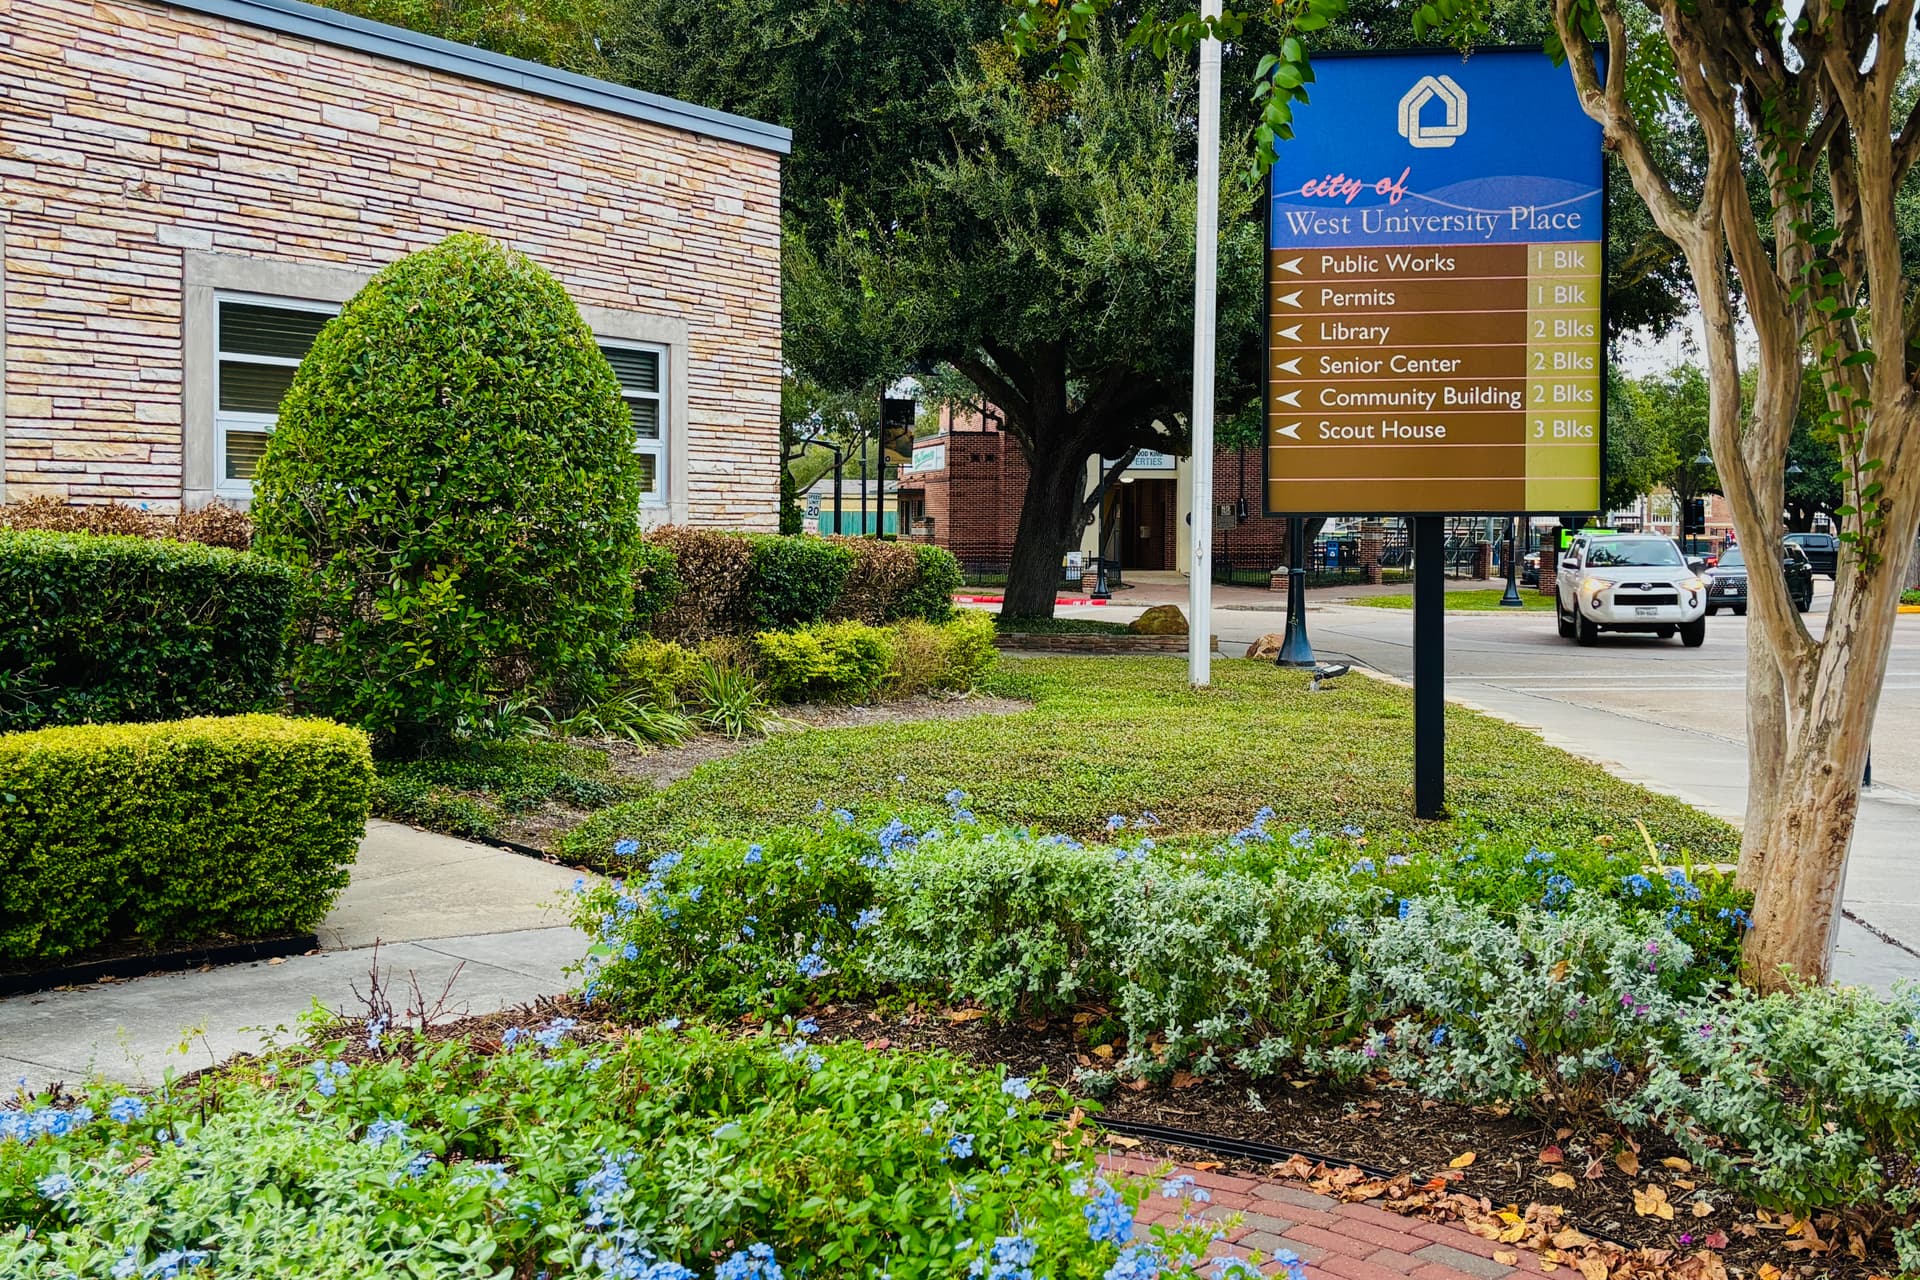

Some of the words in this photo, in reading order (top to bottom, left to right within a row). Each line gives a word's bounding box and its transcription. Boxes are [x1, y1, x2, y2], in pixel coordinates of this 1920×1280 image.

[1301, 172, 1362, 205] city
[1375, 166, 1411, 206] of
[1286, 210, 1351, 236] West
[1360, 206, 1498, 238] University
[1509, 205, 1581, 231] Place
[1320, 255, 1379, 274] Public
[1385, 252, 1456, 271] Works
[1554, 250, 1585, 269] Blk
[1320, 288, 1396, 307] Permits
[1555, 285, 1586, 304] Blk
[1320, 322, 1390, 345] Library
[1534, 319, 1546, 338] 2
[1554, 319, 1594, 338] Blks
[1319, 356, 1383, 374] Senior
[1389, 354, 1461, 373] Center
[1534, 352, 1546, 371] 2
[1553, 351, 1594, 370] Blks
[1319, 388, 1437, 410] Community
[1443, 387, 1522, 409] Building
[1533, 384, 1545, 403] 2
[1553, 384, 1593, 403] Blks
[1319, 420, 1376, 439] Scout
[1381, 420, 1447, 438] House
[1533, 420, 1545, 438] 3
[1553, 420, 1594, 438] Blks
[808, 506, 820, 516] 20
